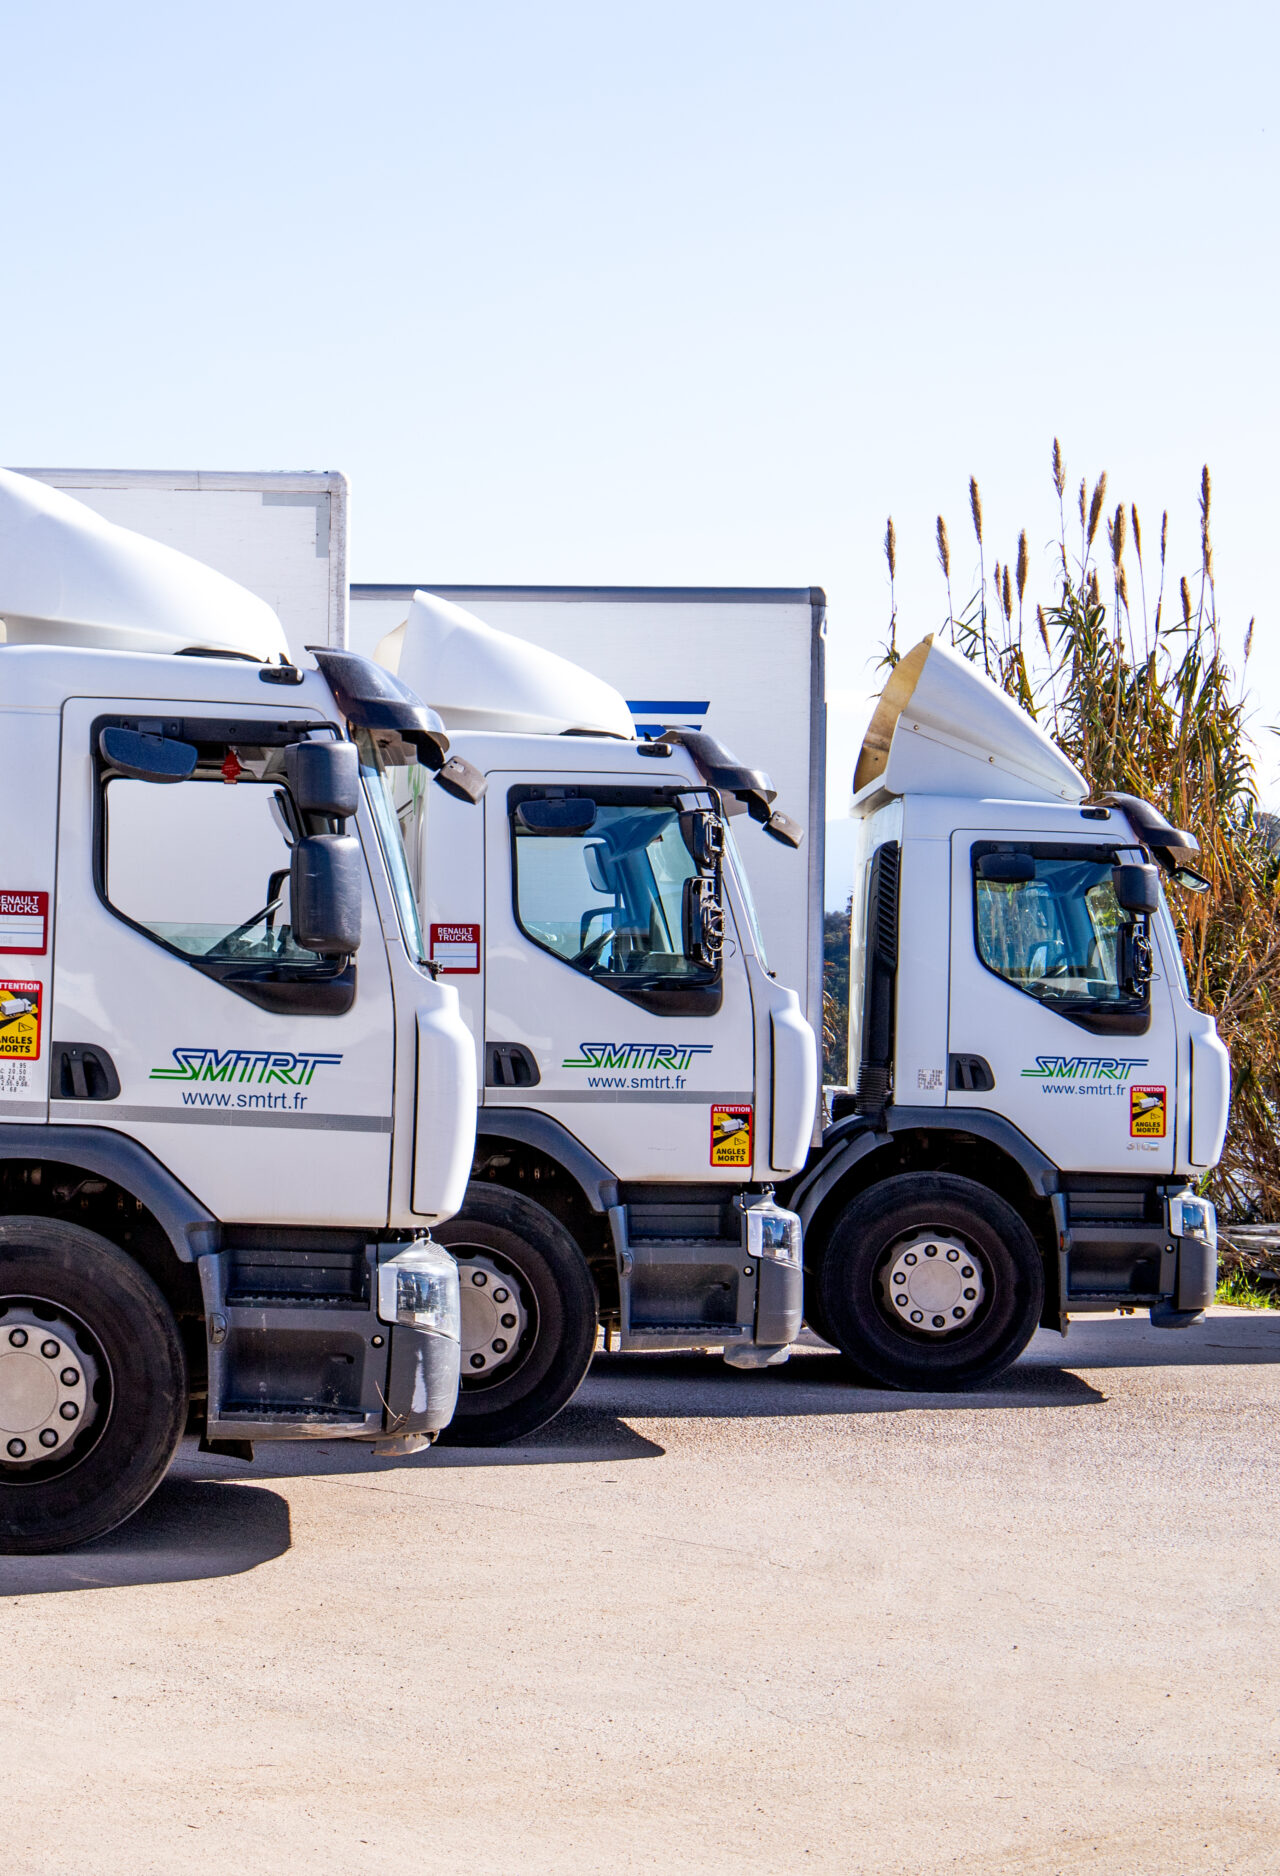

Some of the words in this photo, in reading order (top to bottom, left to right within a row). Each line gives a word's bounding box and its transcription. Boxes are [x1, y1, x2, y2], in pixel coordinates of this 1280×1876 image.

[437, 927, 473, 936] RENAULT
[438, 934, 473, 942] TRUCKS
[562, 1042, 714, 1070] SMTRT
[149, 1047, 344, 1086] SMTRT
[1020, 1056, 1149, 1080] SMTRT
[587, 1075, 687, 1089] www.smtrt.fr
[1042, 1084, 1126, 1096] www.smtrt.fr
[182, 1091, 308, 1110] www.smtrt.fr
